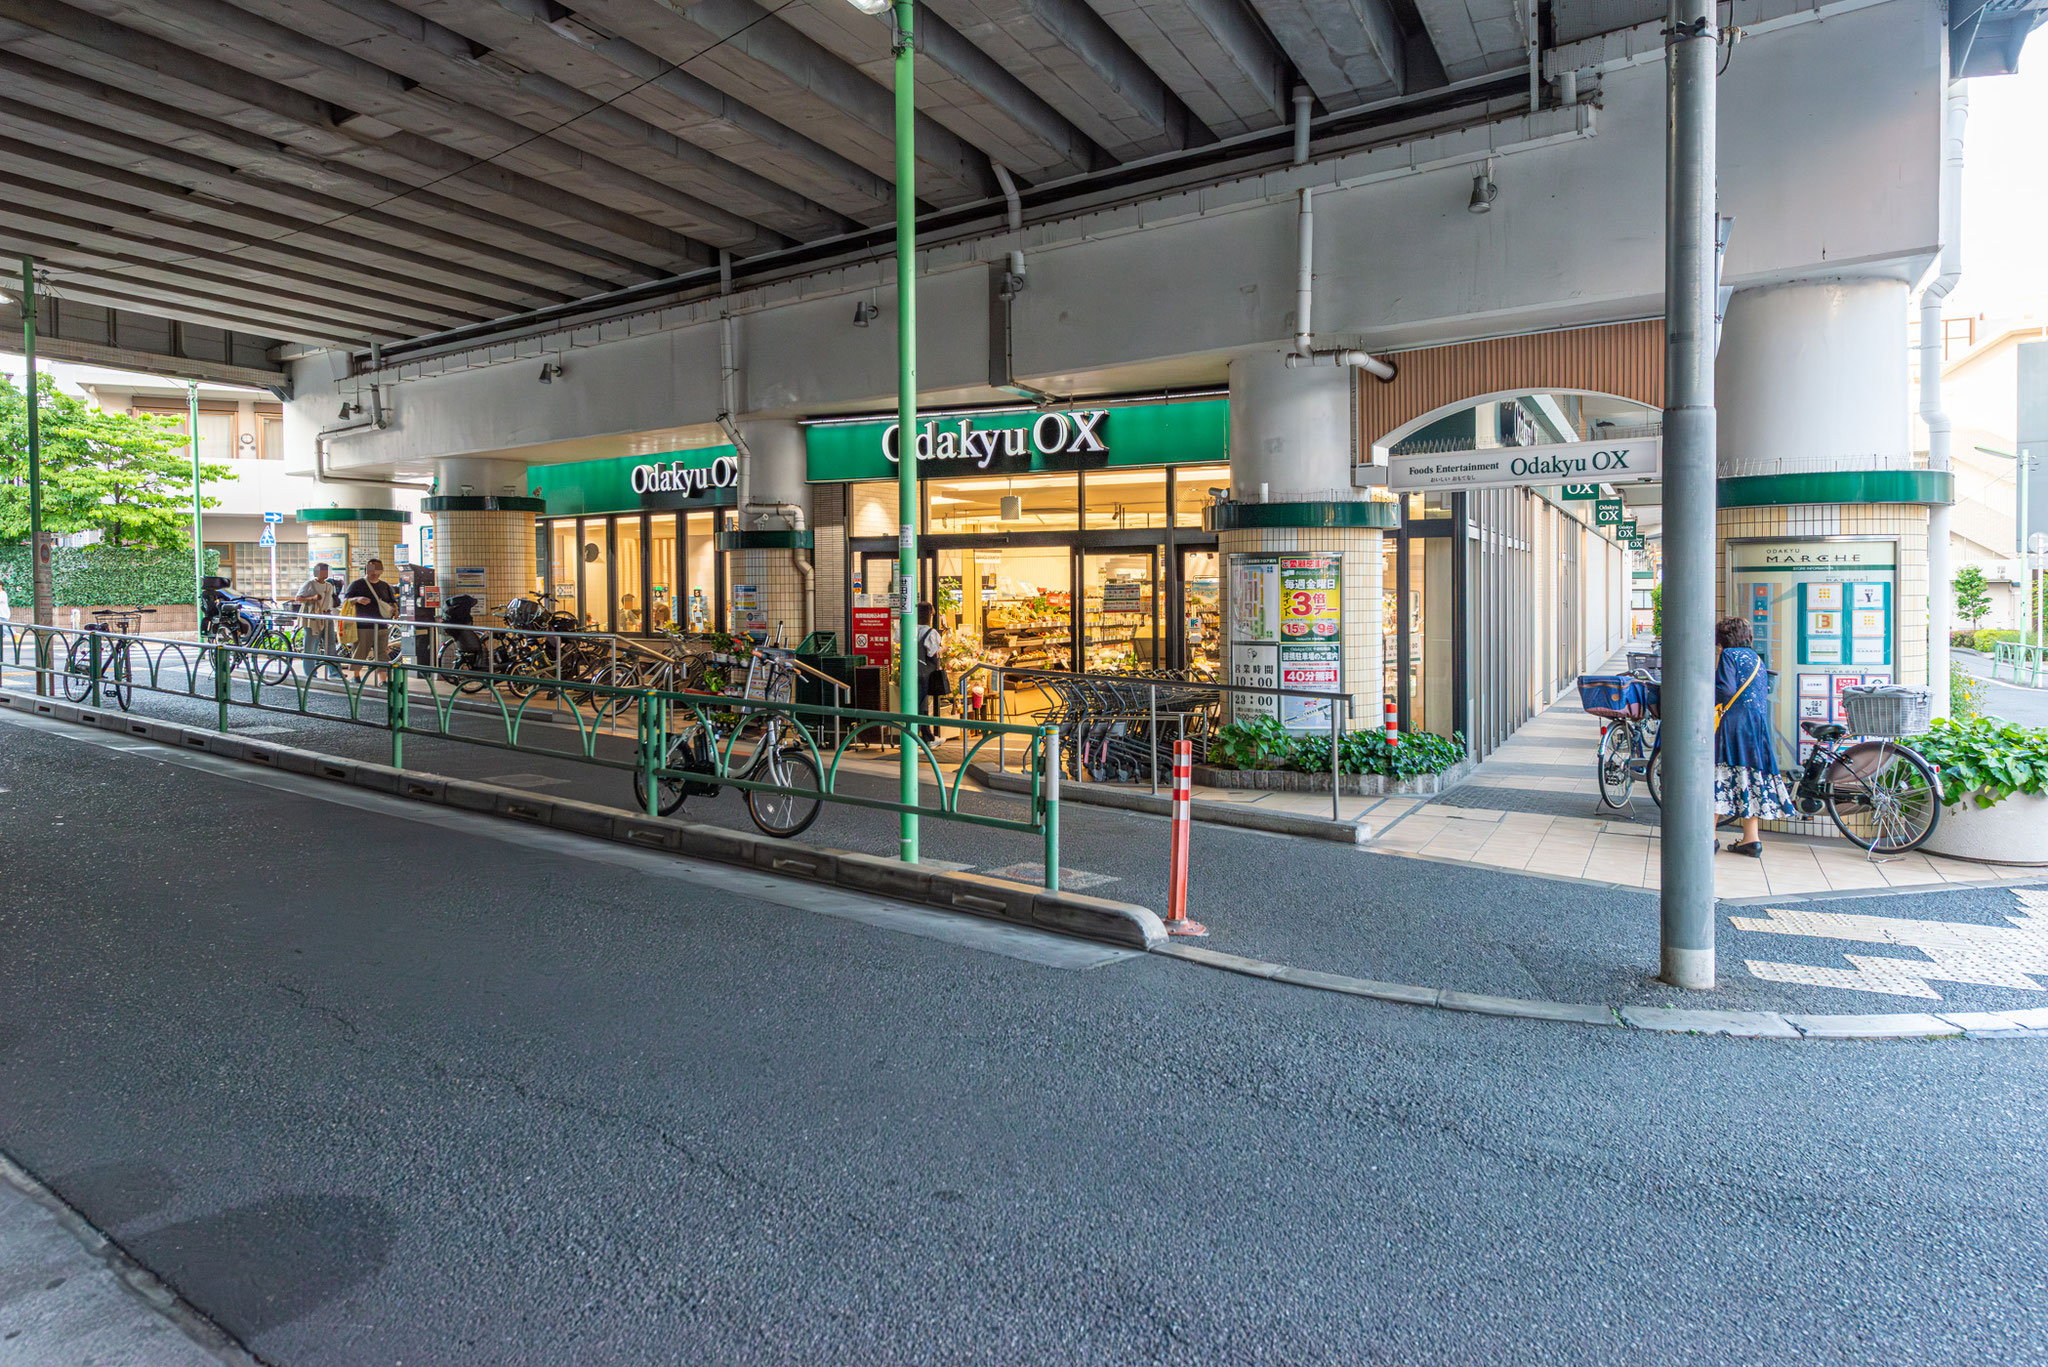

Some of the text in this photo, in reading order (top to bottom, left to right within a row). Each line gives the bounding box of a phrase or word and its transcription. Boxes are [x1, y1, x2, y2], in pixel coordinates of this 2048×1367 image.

[1033, 410, 1109, 454] OX
[1408, 450, 1630, 477] Foods Entertainment Odakyu OX
[631, 461, 709, 498] Odakyu
[1567, 484, 1595, 495] OX
[1598, 504, 1620, 512] Odakyu
[1598, 510, 1619, 521] OX
[1618, 529, 1634, 538] OX
[1766, 554, 1861, 563] MARCHE
[1291, 591, 1312, 616] 3
[1235, 694, 1273, 707] 23:00
